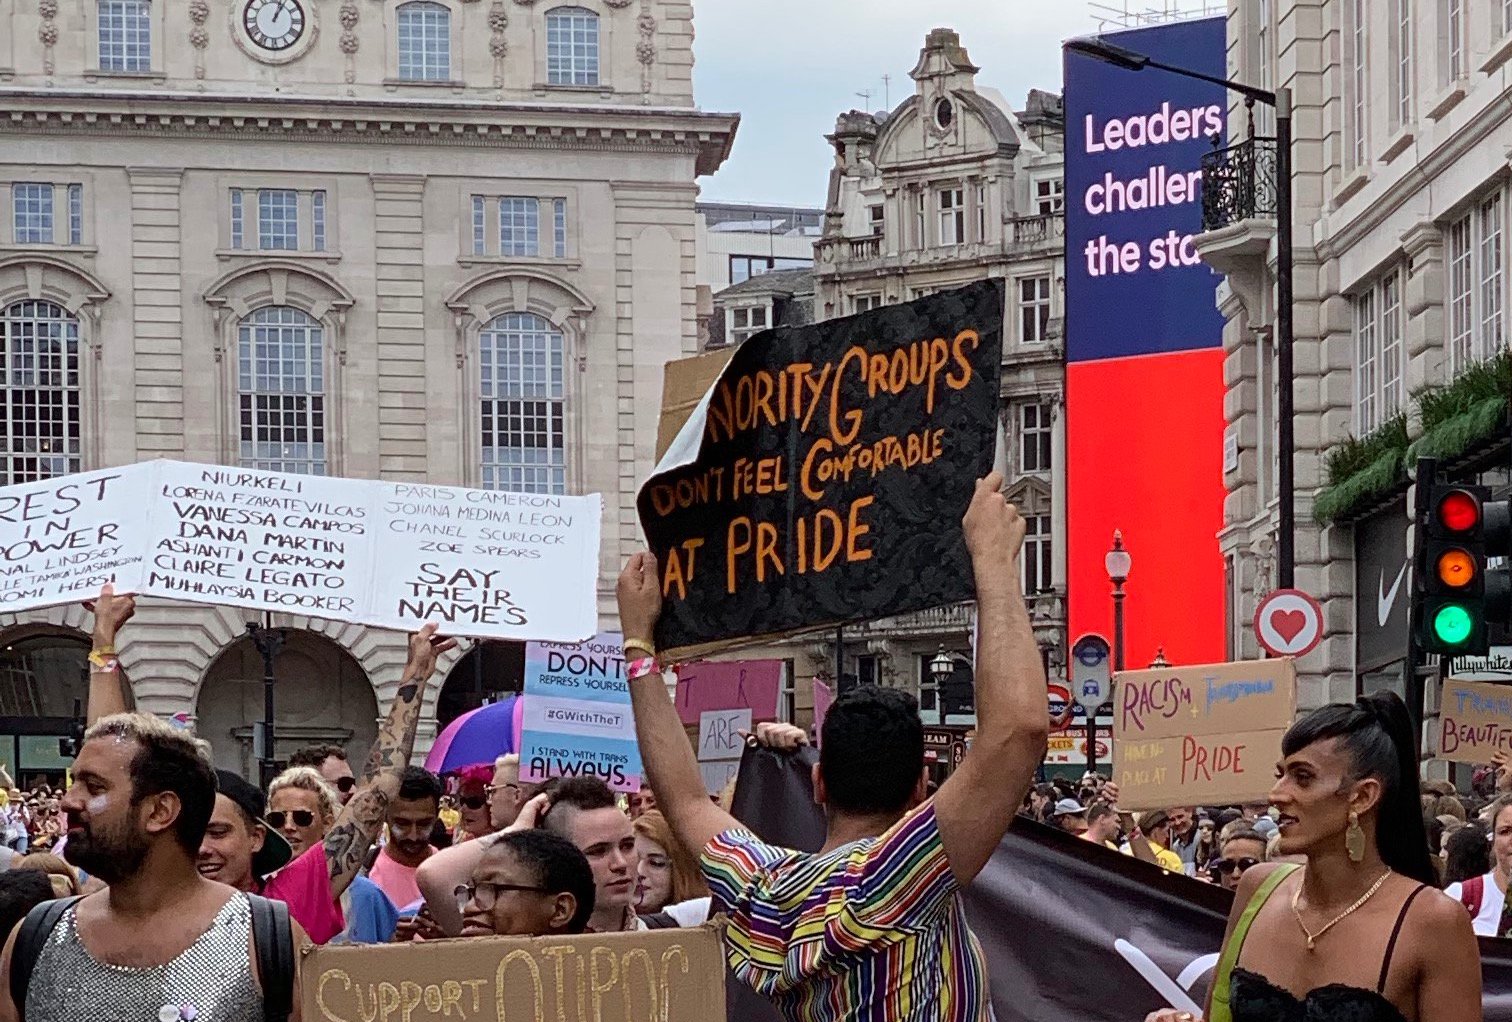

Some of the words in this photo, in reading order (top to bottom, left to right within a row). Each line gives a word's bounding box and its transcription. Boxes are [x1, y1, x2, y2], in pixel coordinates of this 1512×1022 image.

[1085, 102, 1222, 153] Leaders
[1085, 236, 1141, 277] the
[706, 361, 831, 443] NORITY
[829, 329, 979, 446] GROUPS
[652, 464, 724, 517] DON'T
[732, 455, 789, 501] FEEL
[800, 427, 946, 501] COMFORTABLE
[0, 474, 122, 523] REST
[162, 484, 225, 502] LORENA
[395, 485, 456, 501] PARIS
[466, 490, 561, 508] CAMERON
[24, 516, 71, 539] IN
[173, 501, 277, 527] VANESSA
[283, 514, 365, 535] CAMPOS
[457, 505, 511, 523] MEDINA
[519, 511, 573, 528] LEON
[177, 520, 248, 544] DANA
[389, 519, 467, 538] CHANEL
[478, 527, 565, 545] SCURLOCK
[45, 544, 123, 570] LINDSEY
[156, 538, 244, 563] ASHANTI
[252, 550, 345, 571] CARMON
[418, 540, 463, 555] ZOE
[472, 544, 541, 559] SPEARS
[662, 537, 705, 601] AT
[727, 495, 876, 594] PRIDE
[58, 572, 116, 594] HERSI
[154, 554, 235, 579] CLAIRE
[245, 567, 345, 589] LEGATO
[417, 562, 500, 588] SAY
[264, 588, 355, 612] BOOKER
[405, 581, 514, 606] THEIR
[399, 598, 529, 626] NAMES
[547, 650, 626, 679] DON'T
[540, 674, 580, 688] REPRESS
[584, 679, 628, 692] YOURSEL
[547, 709, 621, 726] #GWithTheT
[1122, 677, 1192, 732] RACISM
[704, 714, 740, 750] ARE
[538, 746, 570, 758] STAND
[572, 750, 596, 760] WITH
[600, 752, 629, 764] TRANS
[1181, 734, 1247, 785] PRIDE
